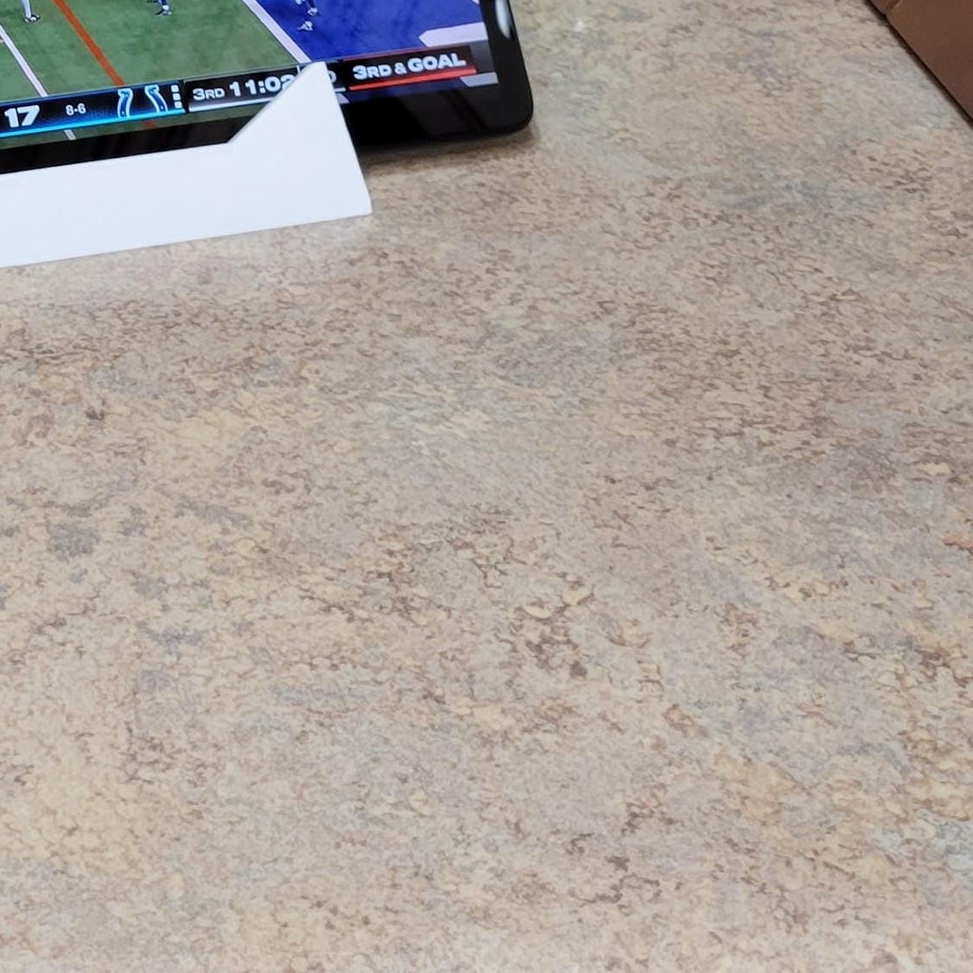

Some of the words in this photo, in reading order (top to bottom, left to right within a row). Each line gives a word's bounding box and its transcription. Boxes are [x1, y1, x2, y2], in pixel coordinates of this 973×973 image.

[352, 63, 392, 81] 3RD
[407, 52, 467, 73] GOAL
[192, 87, 226, 102] 3RD
[3, 104, 41, 128] 17
[65, 102, 87, 116] 8-6
